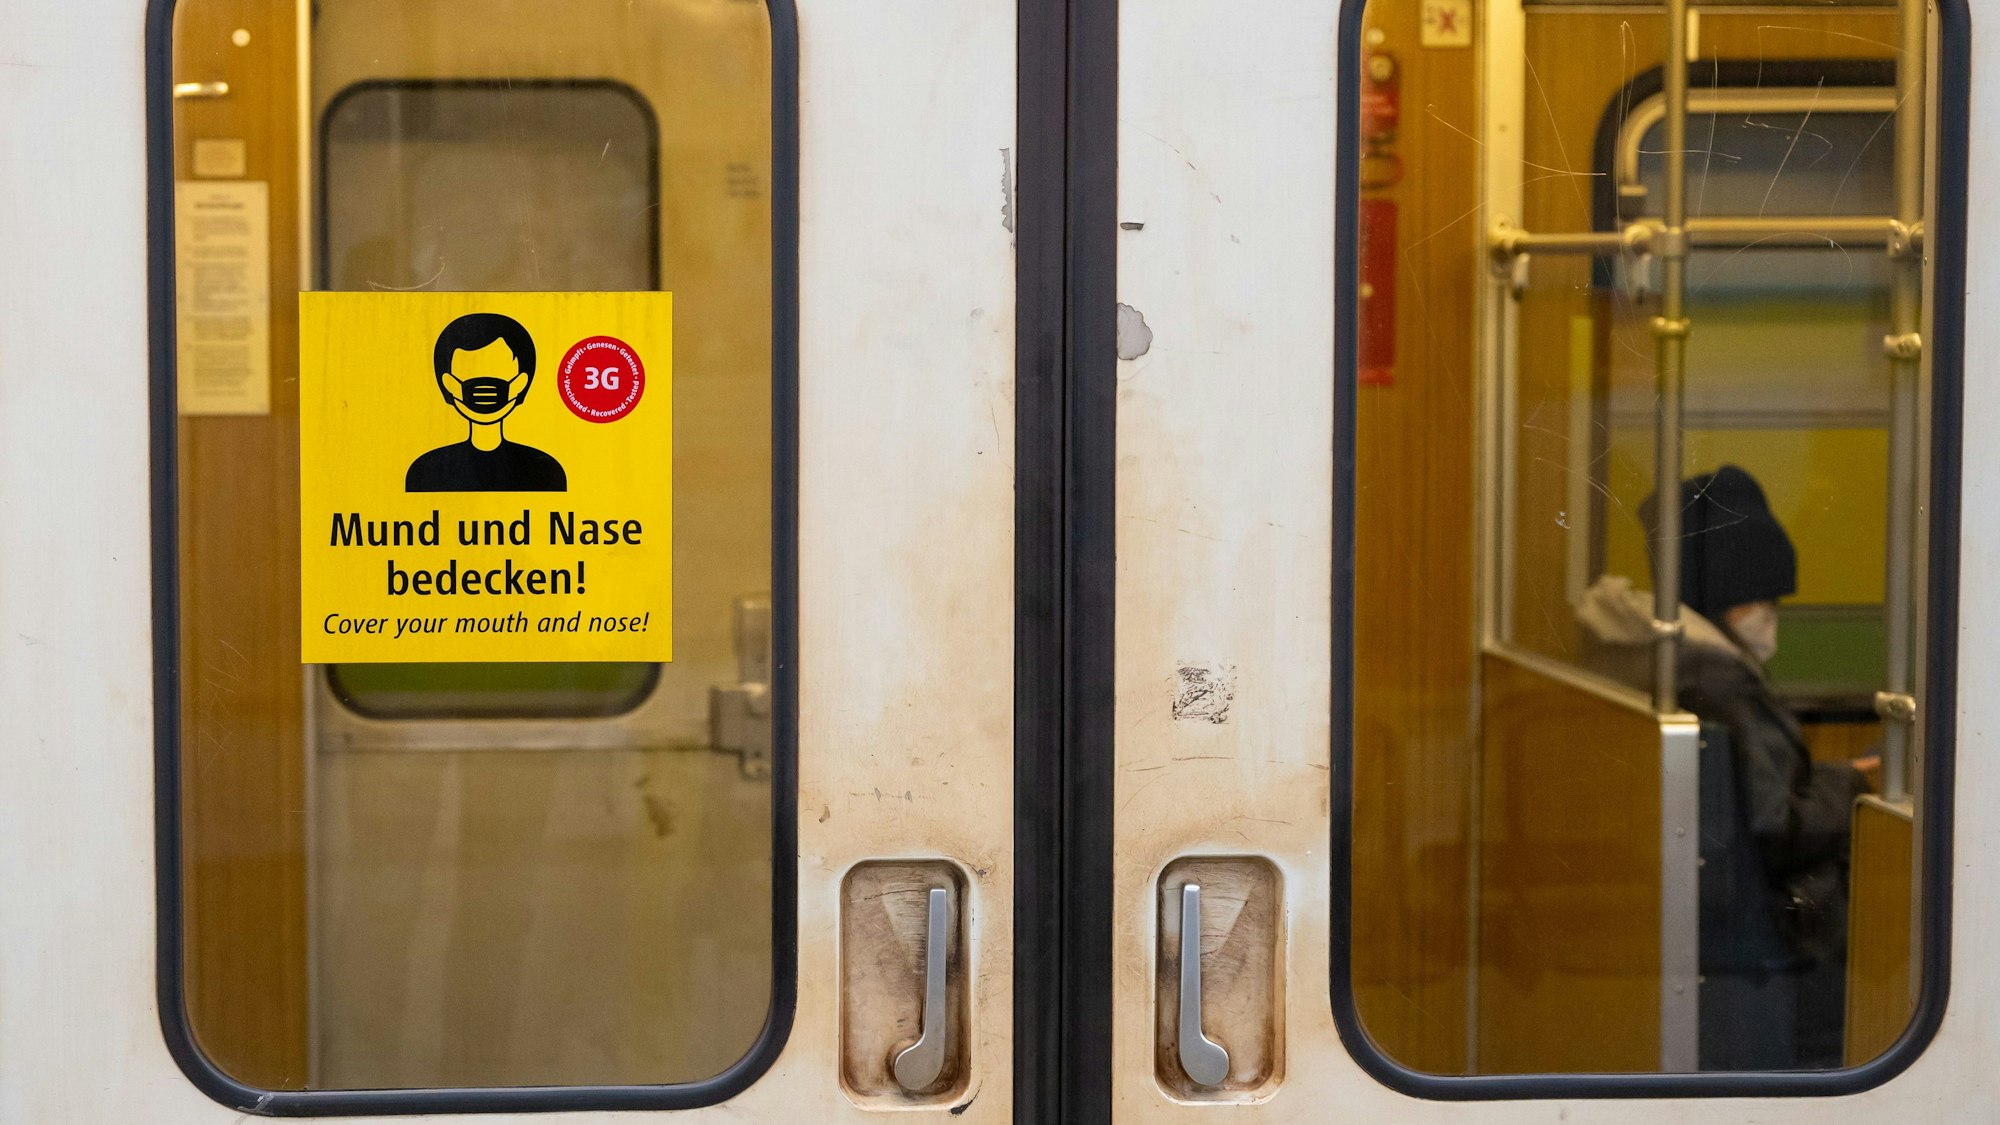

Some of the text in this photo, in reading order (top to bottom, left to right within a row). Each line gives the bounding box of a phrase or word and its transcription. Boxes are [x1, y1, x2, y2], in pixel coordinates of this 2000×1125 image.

[565, 342, 639, 376] Geimpft Genesen Getestet
[584, 366, 619, 390] 3G
[563, 379, 639, 417] Vaccinated Recovered Tested
[330, 509, 643, 546] Mund und Nase
[387, 559, 586, 595] bedecken!
[323, 611, 650, 639] Cover your mouth and nose!
